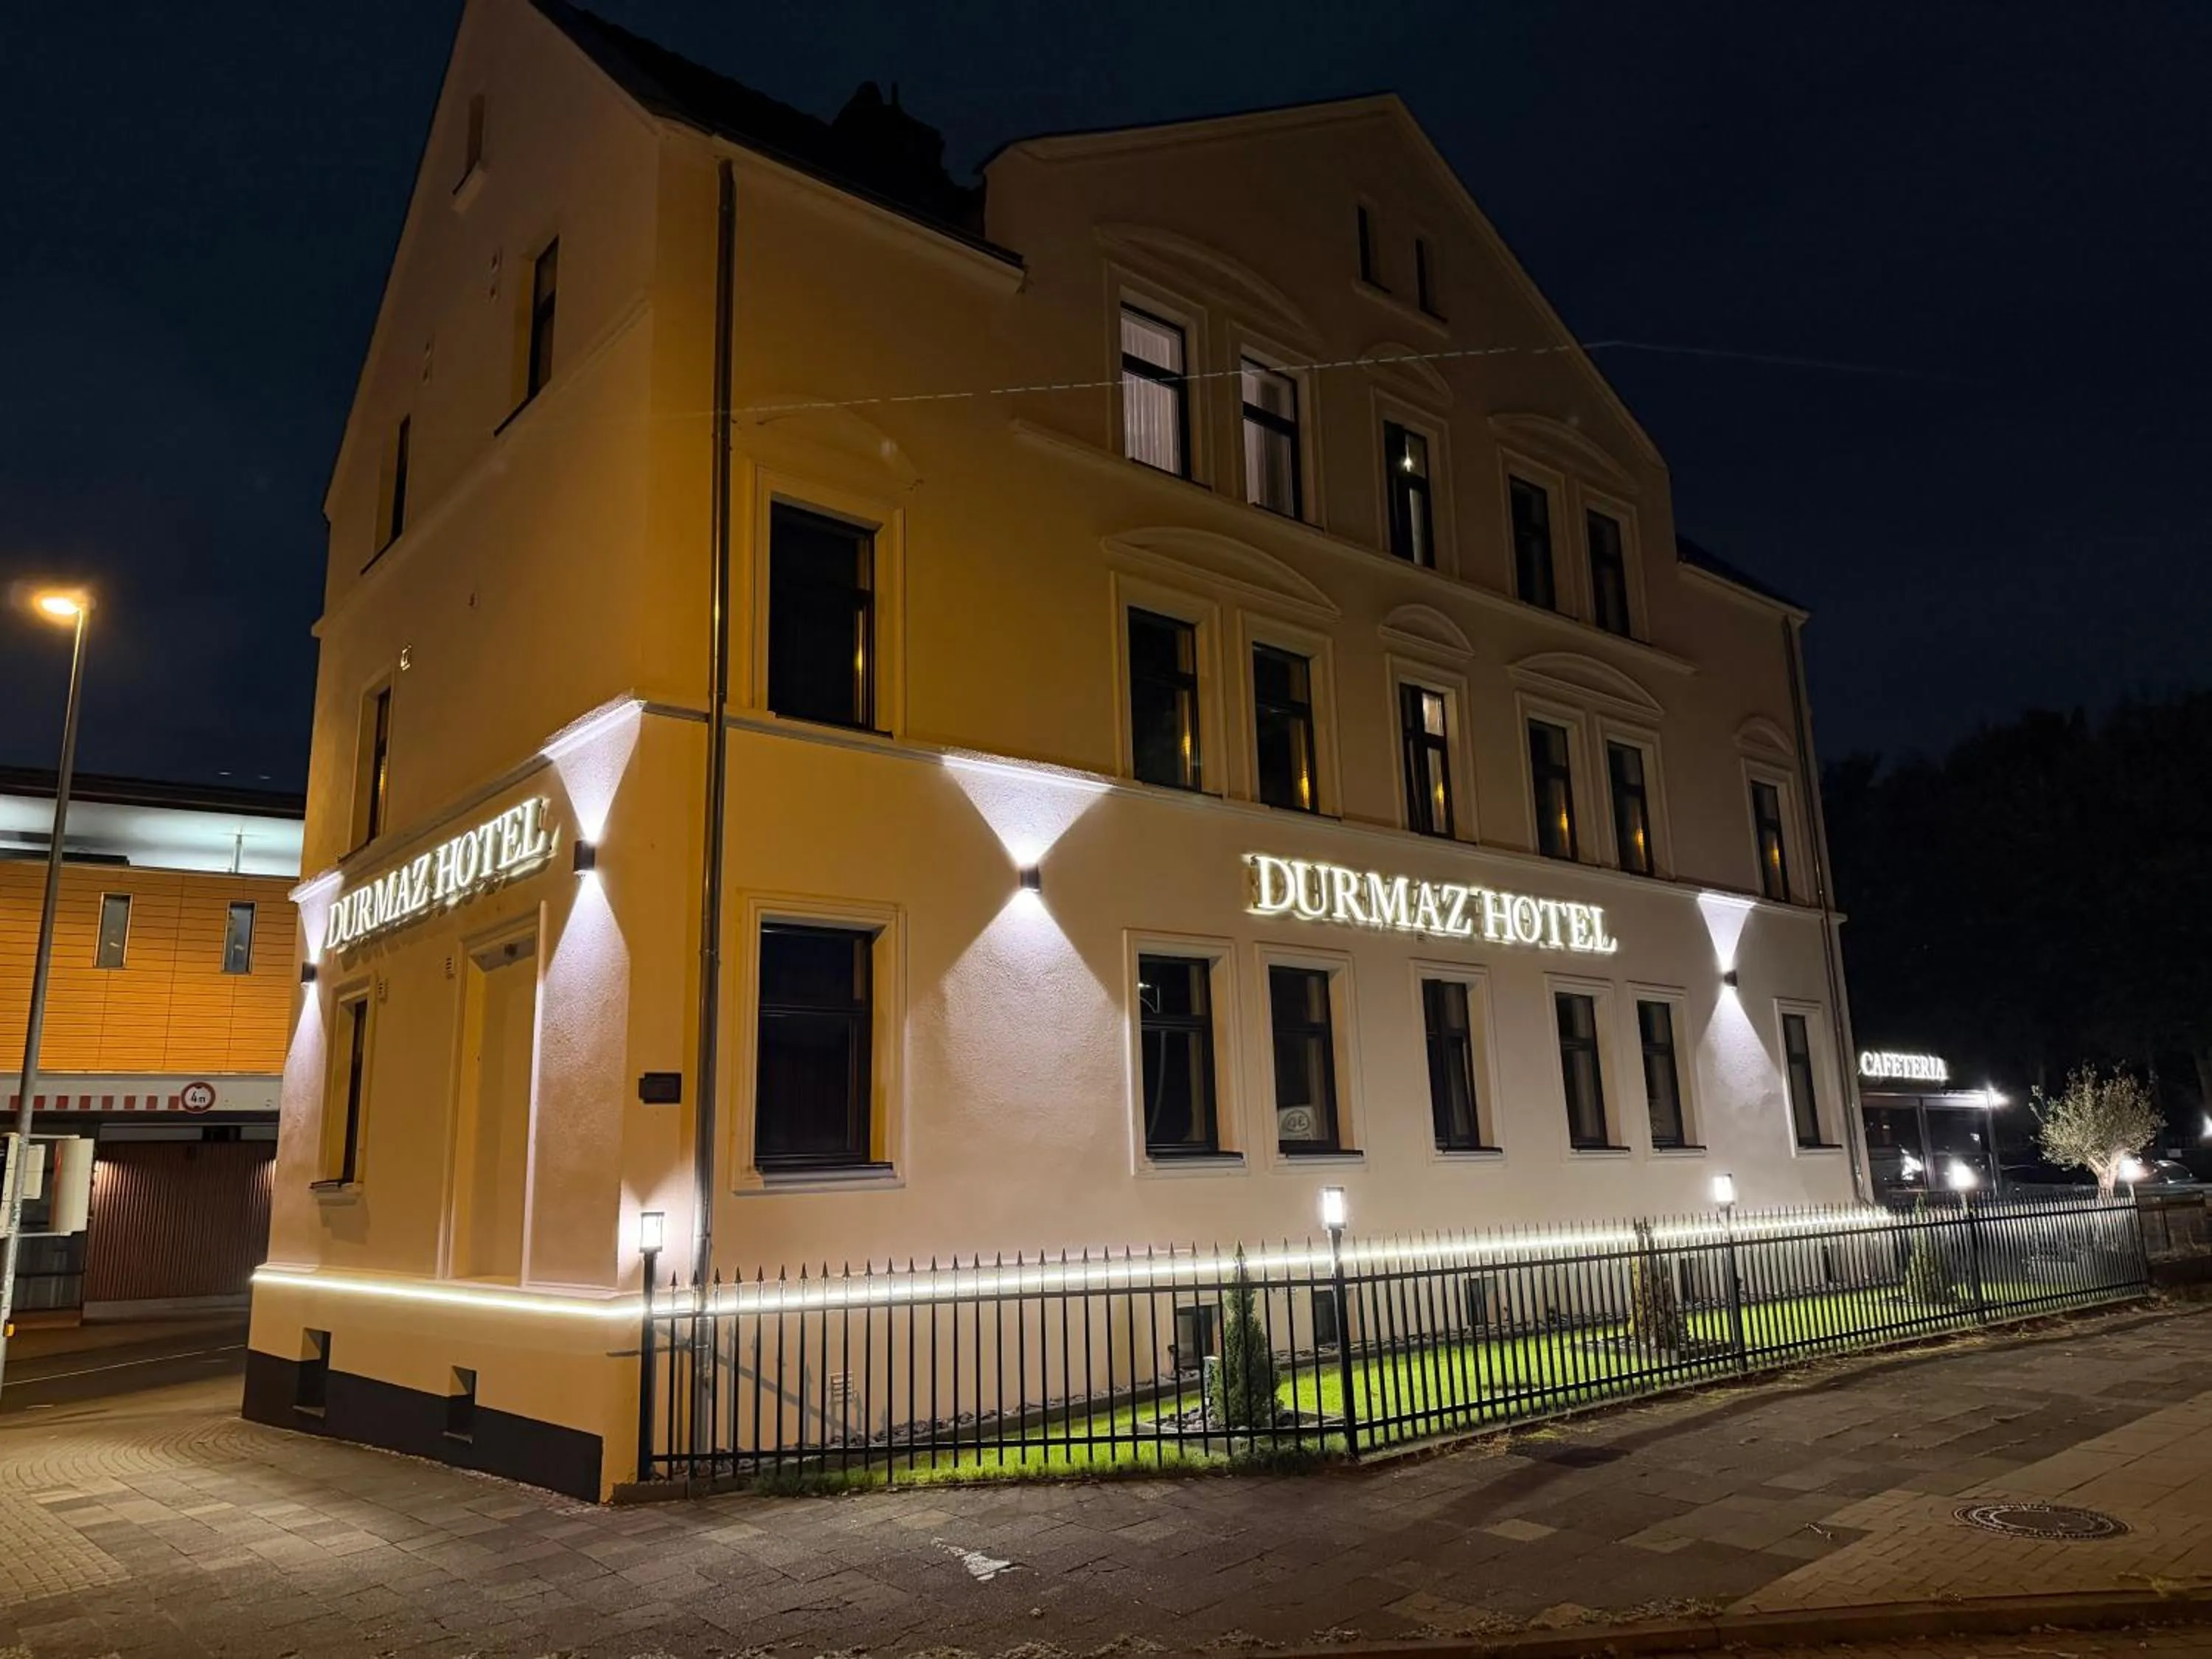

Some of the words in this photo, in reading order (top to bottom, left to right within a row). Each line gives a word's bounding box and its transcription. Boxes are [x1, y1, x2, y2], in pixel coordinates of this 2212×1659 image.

[325, 851, 432, 948] DURMAZ
[433, 797, 549, 899] HOTEL
[1255, 855, 1472, 936] DURMAZ
[1477, 887, 1617, 953] HOTEL
[1860, 1051, 1949, 1080] CAFETERIA
